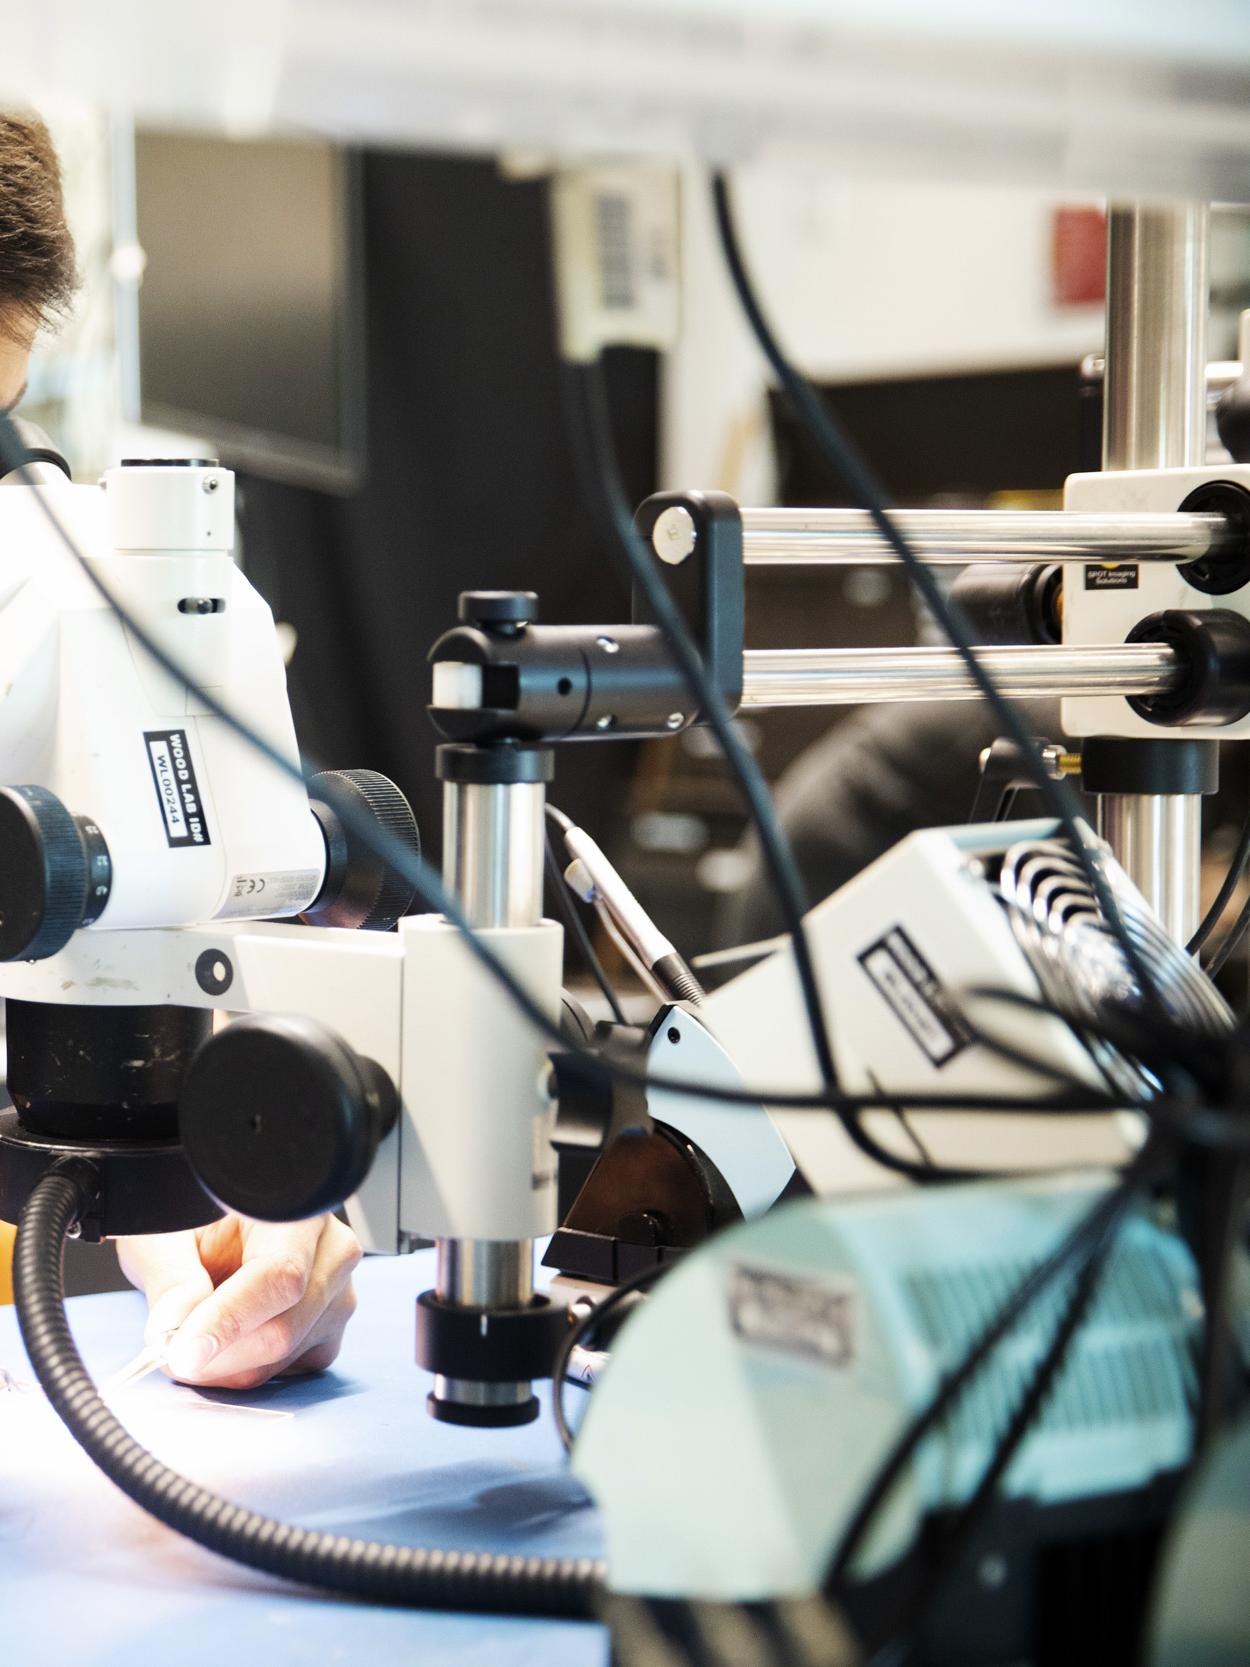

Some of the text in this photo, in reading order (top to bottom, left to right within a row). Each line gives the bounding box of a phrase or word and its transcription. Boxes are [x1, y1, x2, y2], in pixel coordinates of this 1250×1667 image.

[157, 754, 180, 824] WL00244
[170, 733, 204, 842] WOOD LAB ID#
